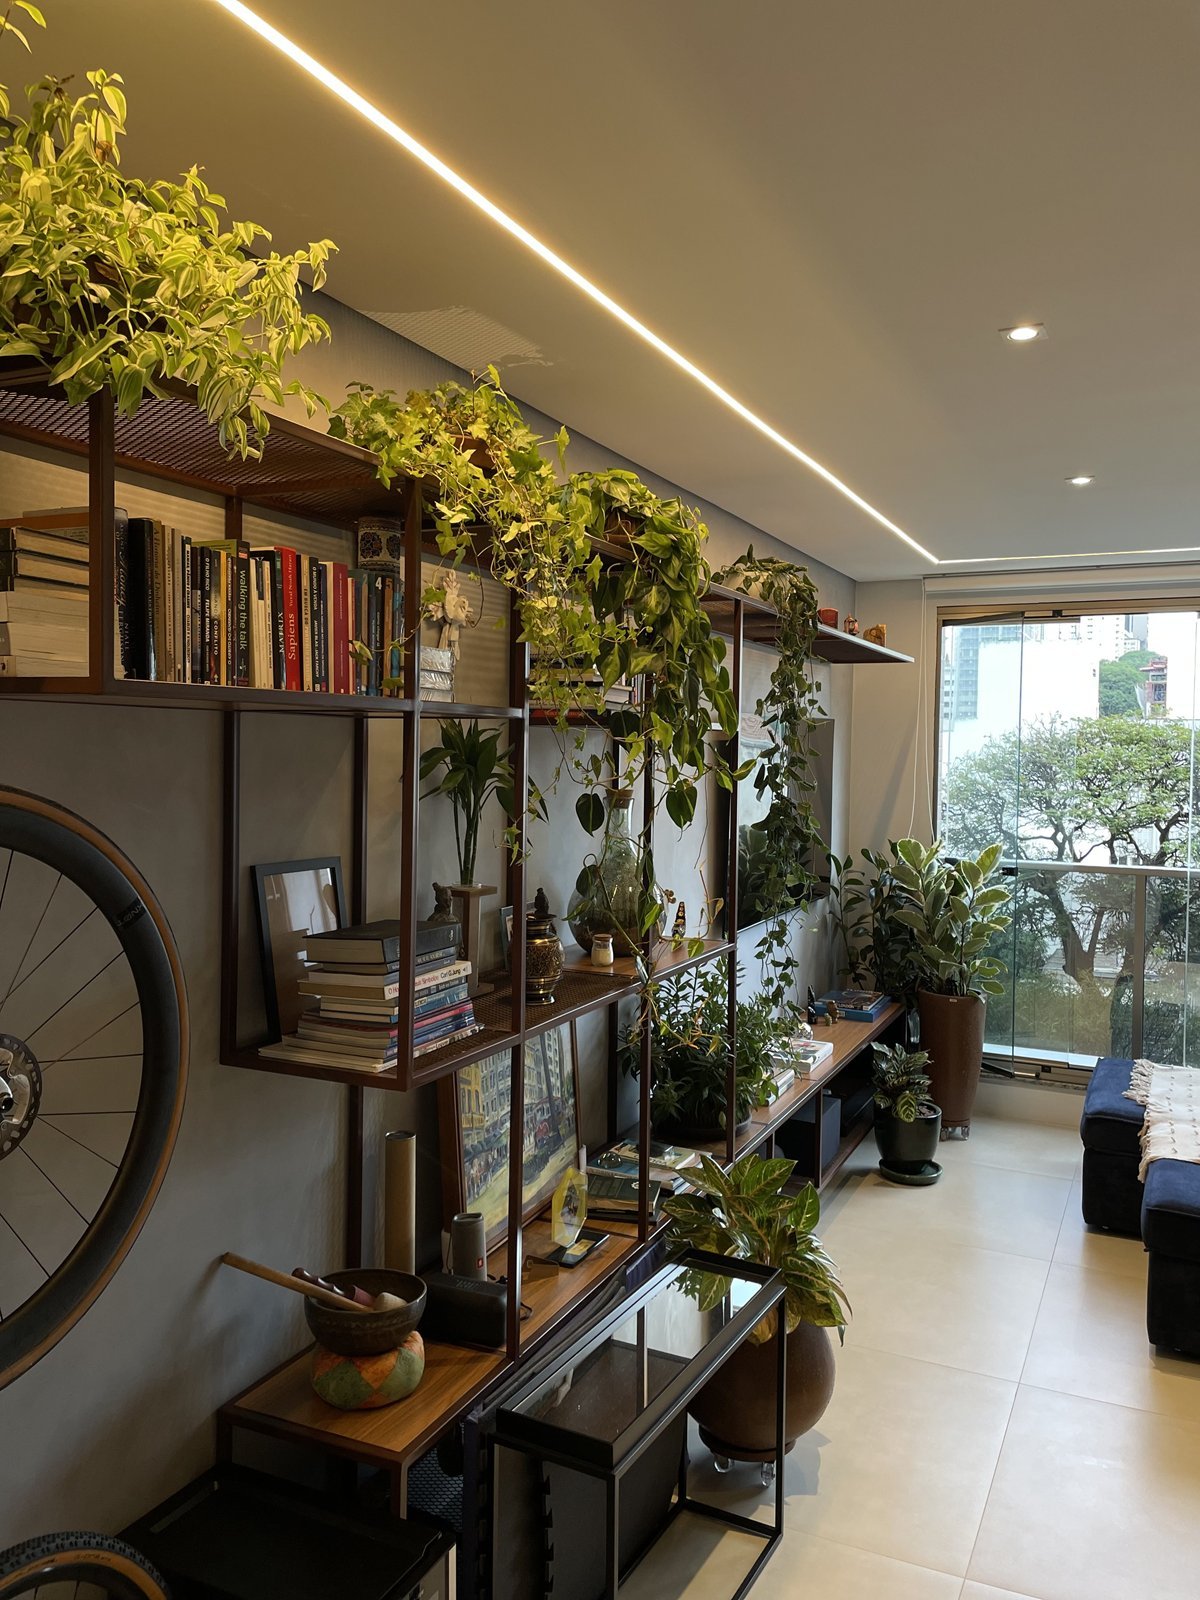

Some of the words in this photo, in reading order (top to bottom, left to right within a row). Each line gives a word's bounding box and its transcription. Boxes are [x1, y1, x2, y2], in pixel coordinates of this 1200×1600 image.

[238, 569, 247, 611] walking
[375, 576, 382, 590] 4
[385, 577, 393, 590] 5
[239, 612, 248, 629] the
[239, 630, 248, 651] talk
[287, 613, 297, 661] Sapiens
[440, 971, 449, 979] Carl
[452, 968, 461, 976] Jung
